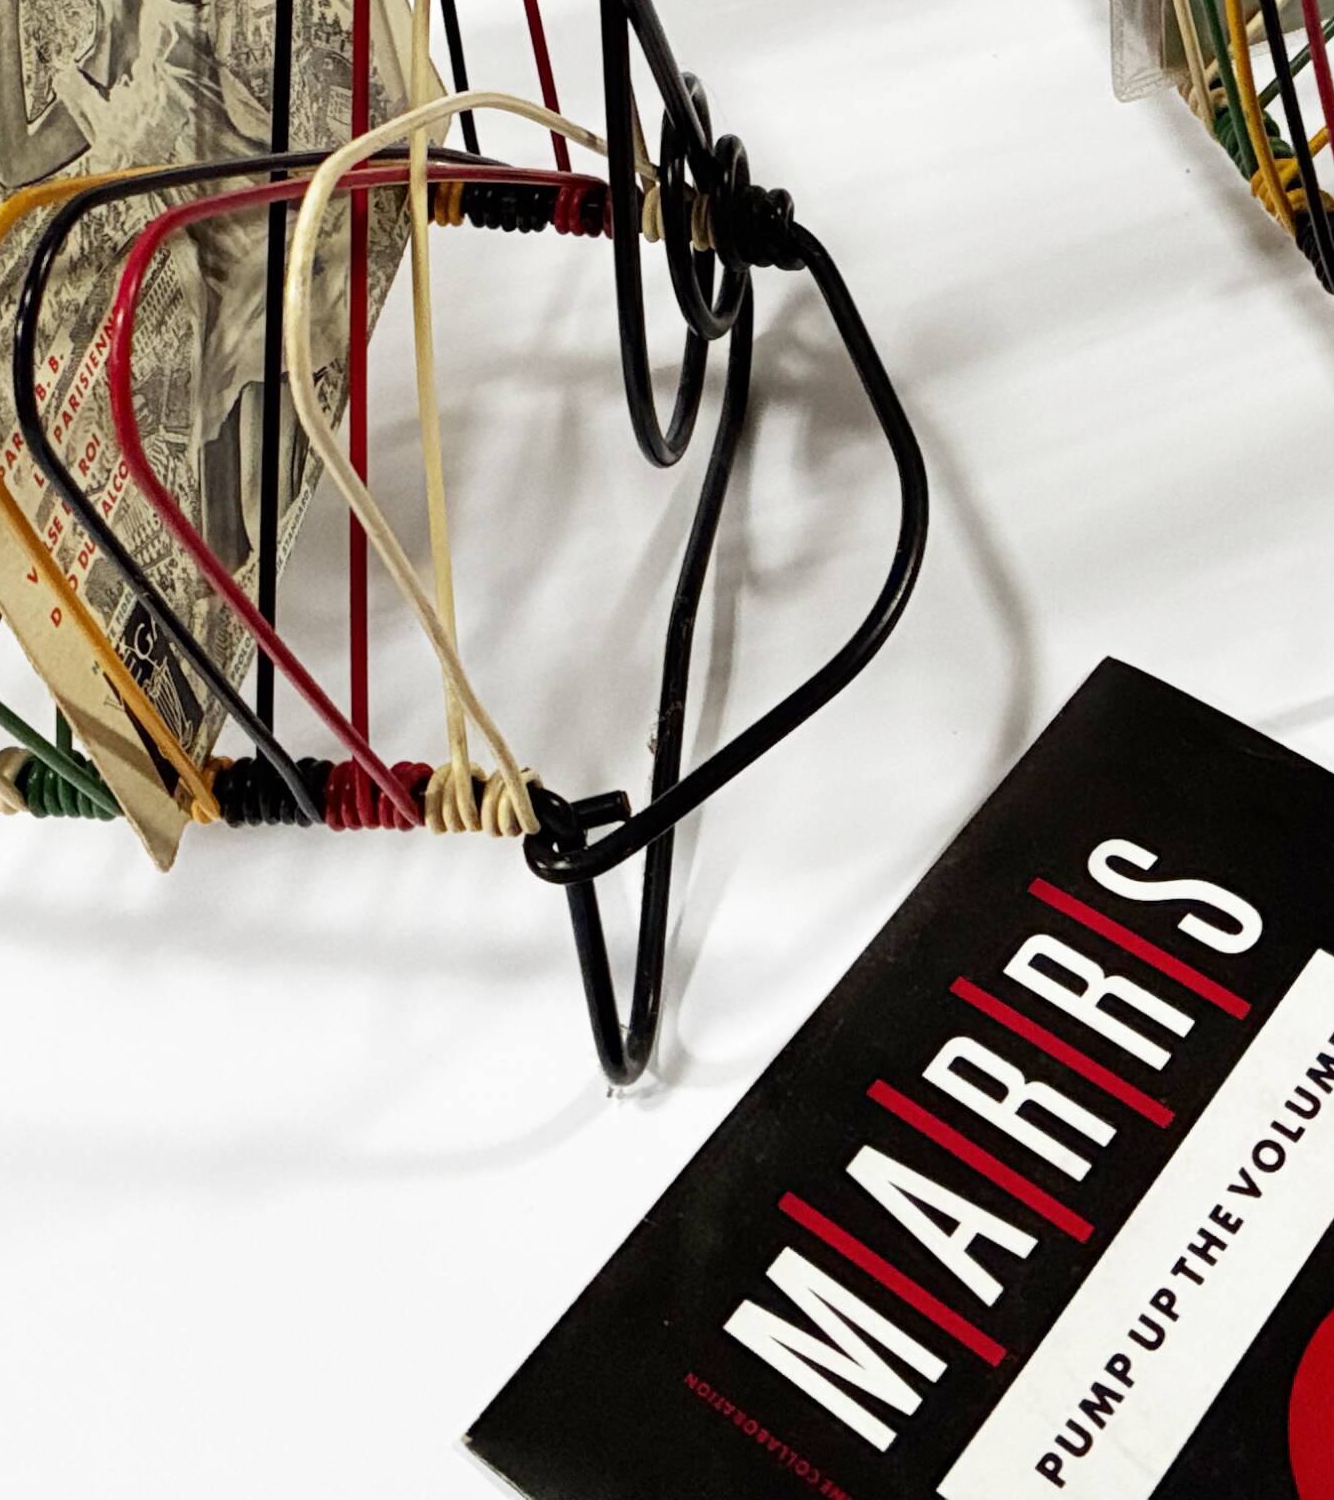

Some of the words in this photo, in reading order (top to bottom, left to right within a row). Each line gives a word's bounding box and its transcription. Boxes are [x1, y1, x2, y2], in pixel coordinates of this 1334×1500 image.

[53, 313, 117, 445] PARISIENN
[77, 432, 101, 477] ROI
[1034, 1352, 1136, 1489] PUMP
[1127, 1287, 1181, 1351] UP
[1170, 1203, 1245, 1285] THE
[684, 1372, 820, 1484] COLLABORATION
